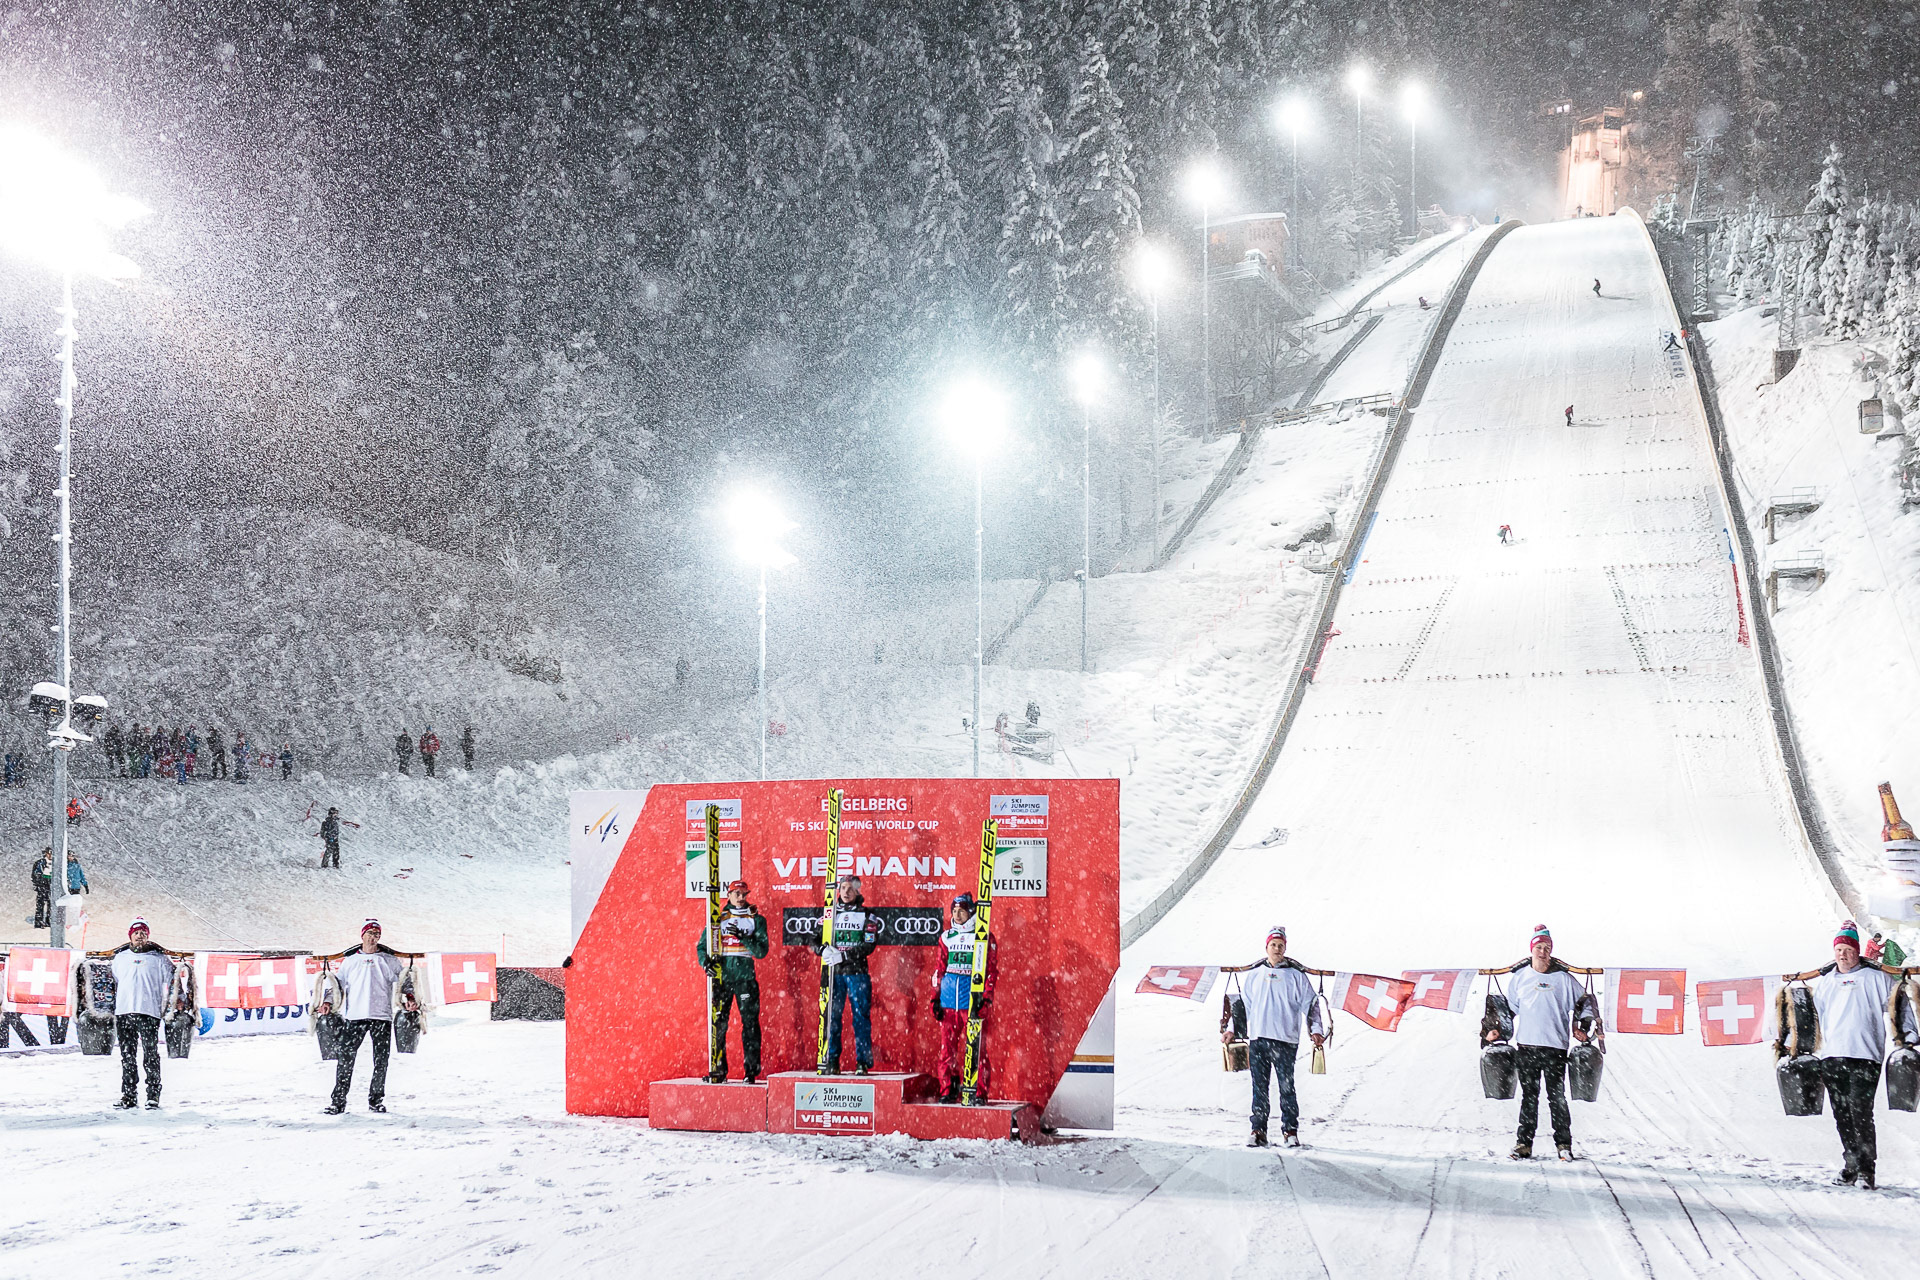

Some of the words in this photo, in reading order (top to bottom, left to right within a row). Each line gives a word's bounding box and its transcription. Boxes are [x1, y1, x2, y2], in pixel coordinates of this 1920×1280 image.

[821, 798, 907, 811] EGELBERG
[790, 822, 805, 831] FIS
[808, 821, 824, 830] SKI
[826, 820, 872, 830] MPING
[876, 820, 915, 830] WORLD
[918, 820, 939, 830] CUP
[995, 816, 1044, 828] VIESSMANN
[827, 787, 837, 883] FISCHER
[978, 819, 995, 924] FSCHER
[993, 879, 1042, 891] VELTINS
[953, 951, 967, 964] 45
[801, 1111, 869, 1128] VIESSMANN
